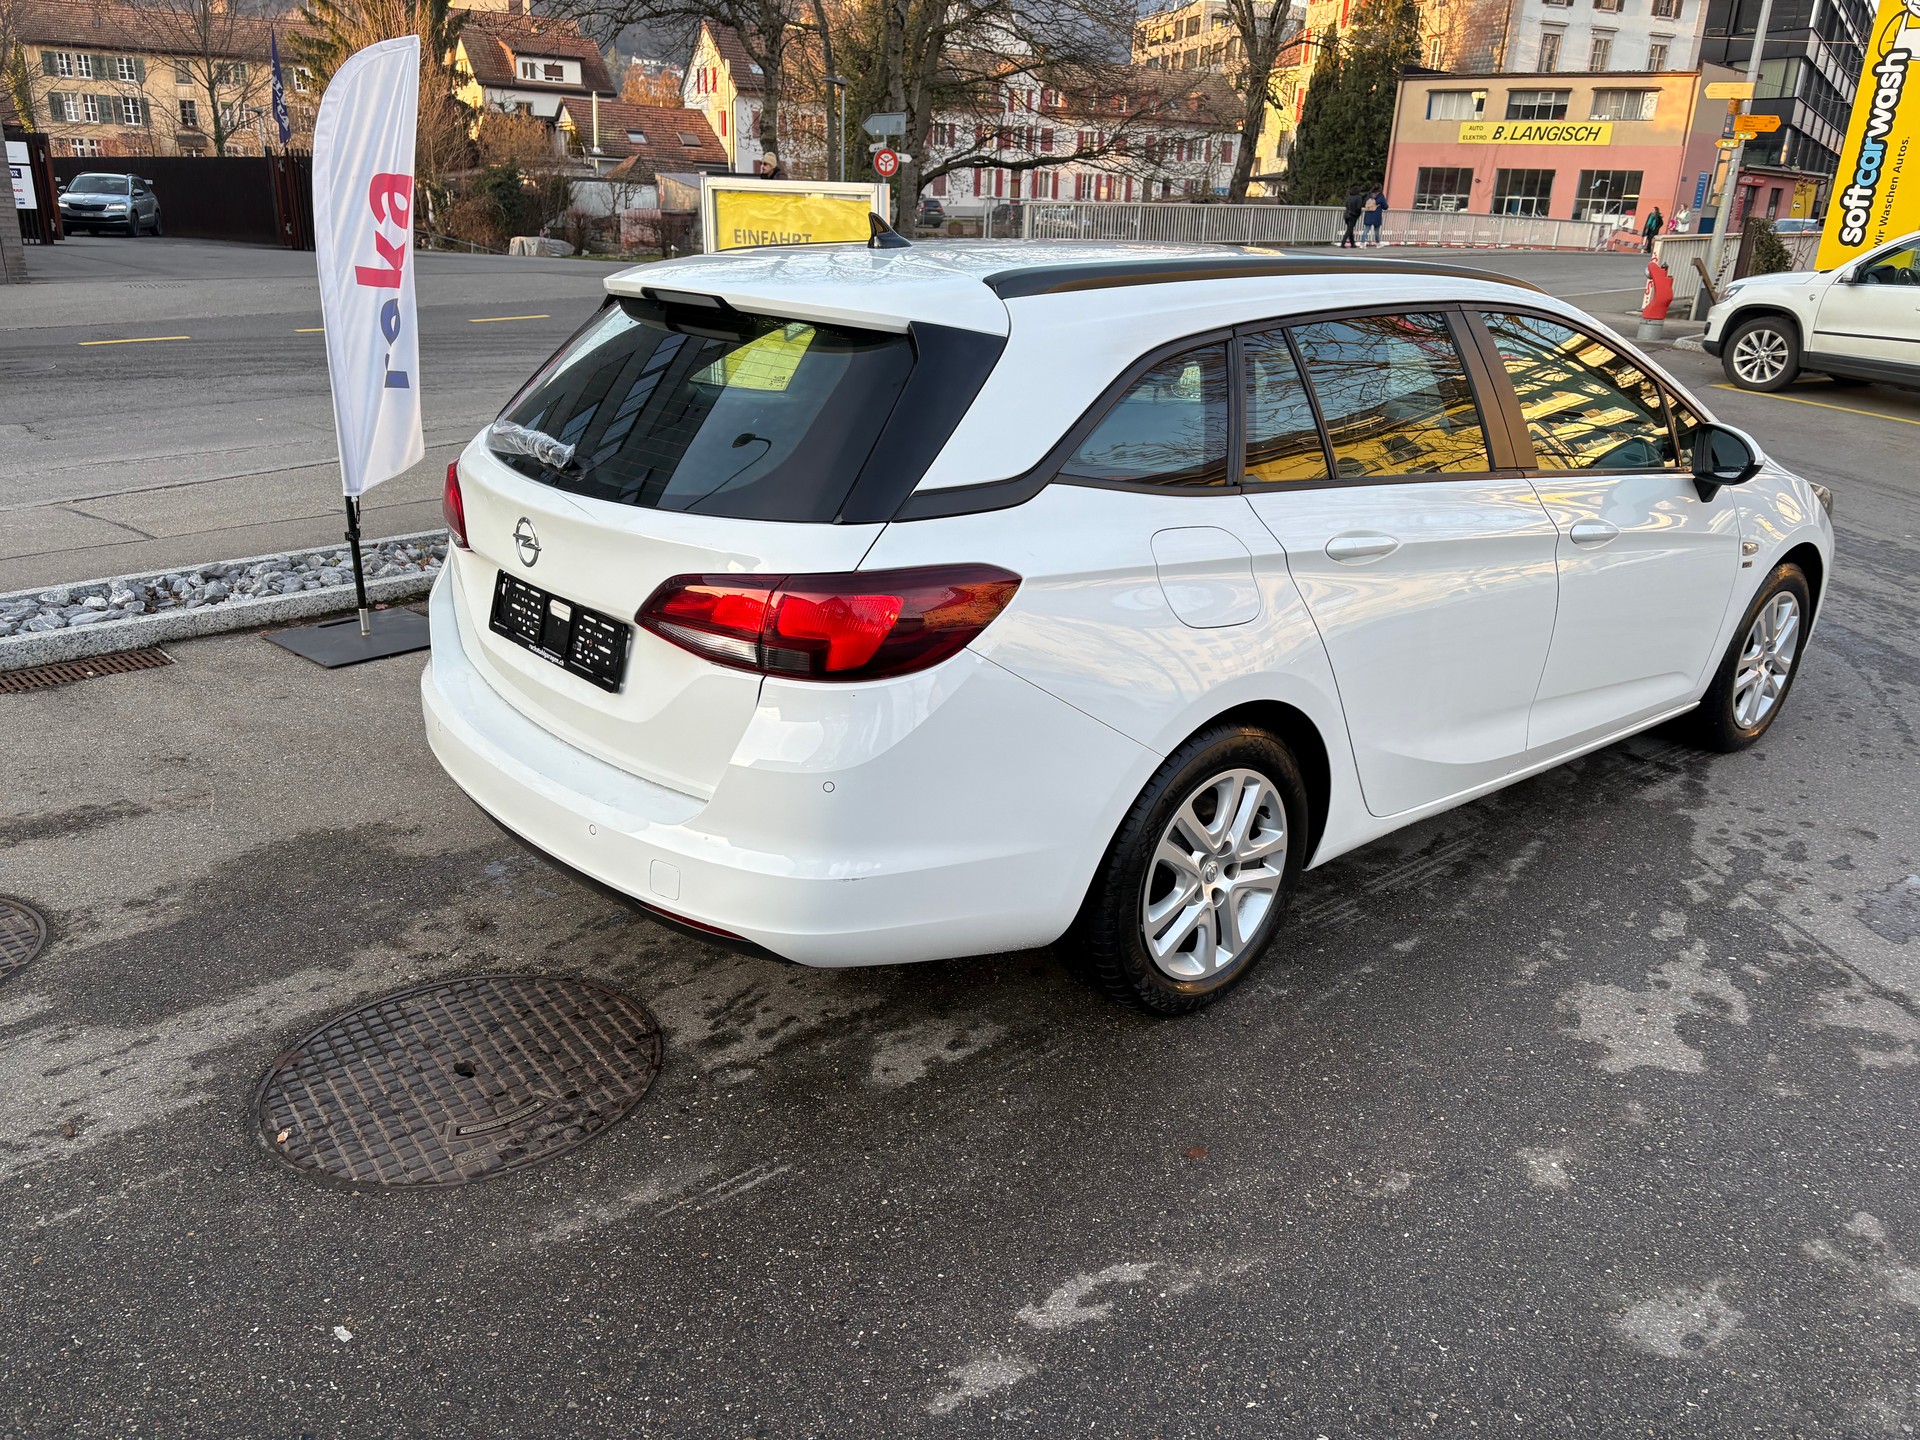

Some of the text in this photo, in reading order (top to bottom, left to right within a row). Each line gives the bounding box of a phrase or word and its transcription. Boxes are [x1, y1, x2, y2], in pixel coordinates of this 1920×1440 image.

[1839, 49, 1910, 246] softcarwash
[1878, 176, 1899, 227] Waschen
[1892, 136, 1910, 174] Autos.
[734, 228, 812, 245] EINFAHRT
